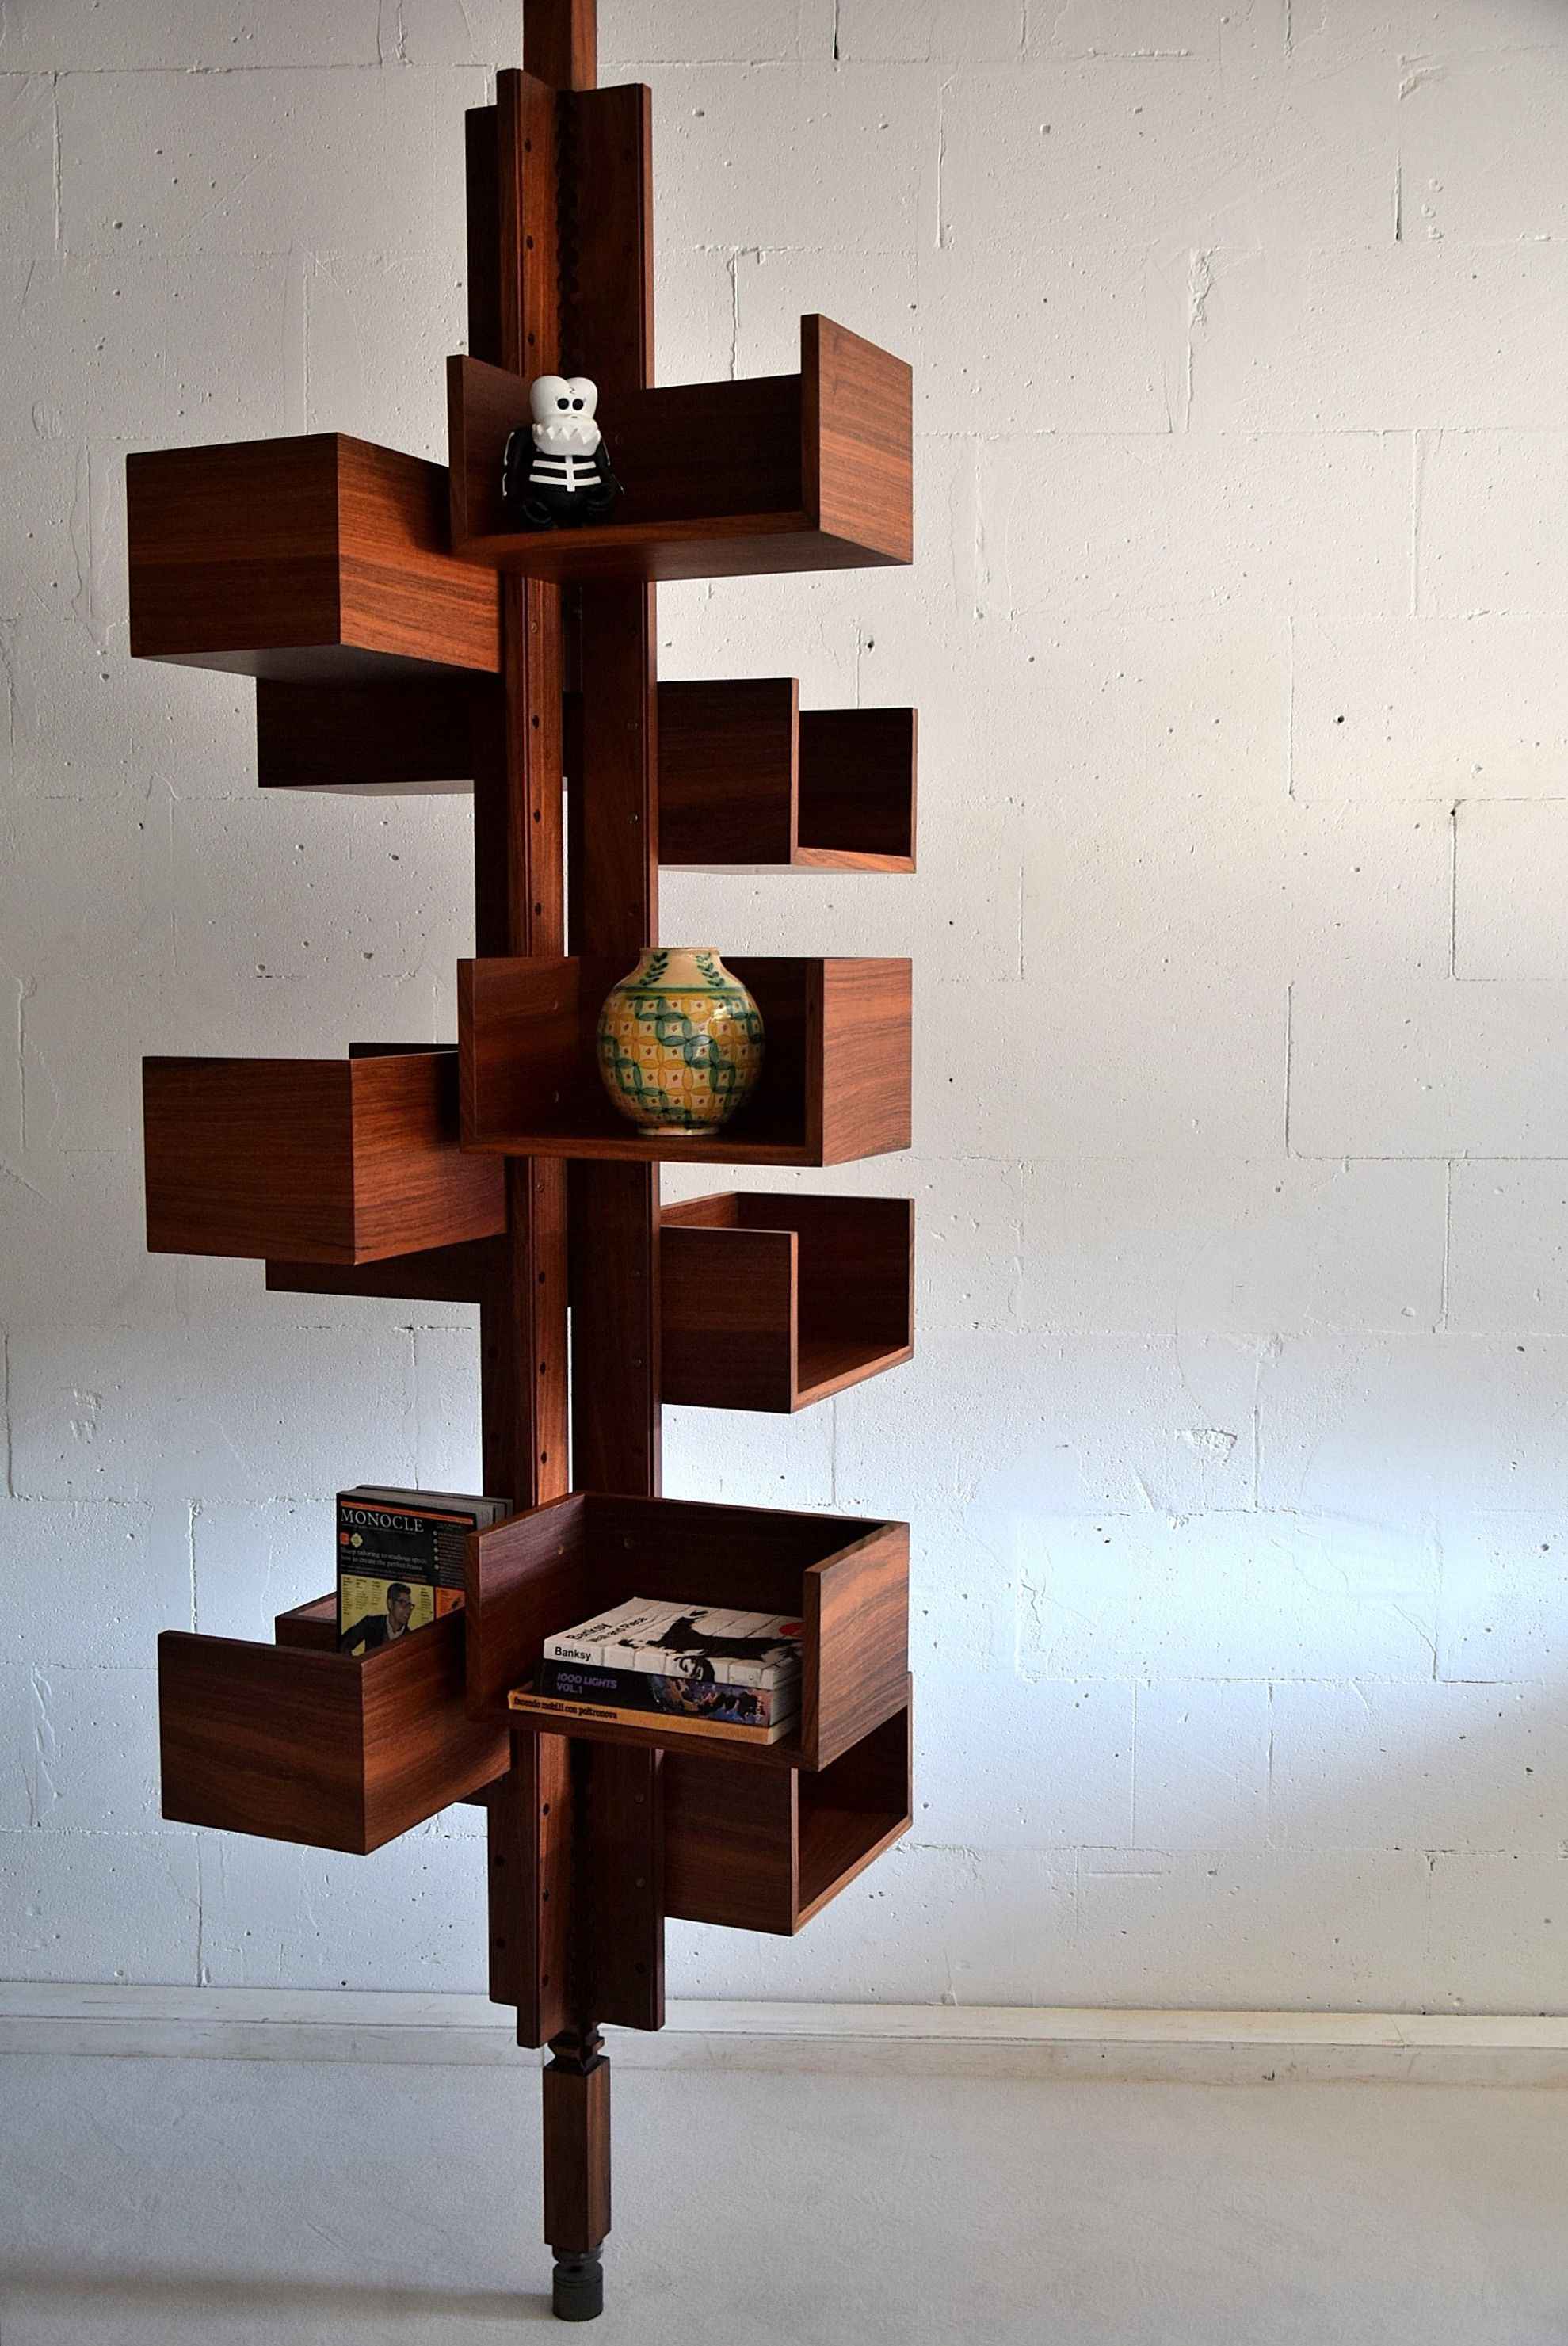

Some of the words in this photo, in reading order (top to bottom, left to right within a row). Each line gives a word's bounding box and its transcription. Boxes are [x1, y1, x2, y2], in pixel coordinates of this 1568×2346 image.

[341, 1509, 424, 1532] MONOCLE
[565, 1623, 612, 1639] Banksy
[555, 1646, 591, 1661] Banksy
[557, 1673, 582, 1684] 1000
[584, 1677, 617, 1689] LIGHTS
[557, 1683, 582, 1694] VOL.1
[578, 1707, 617, 1719] poltronova
